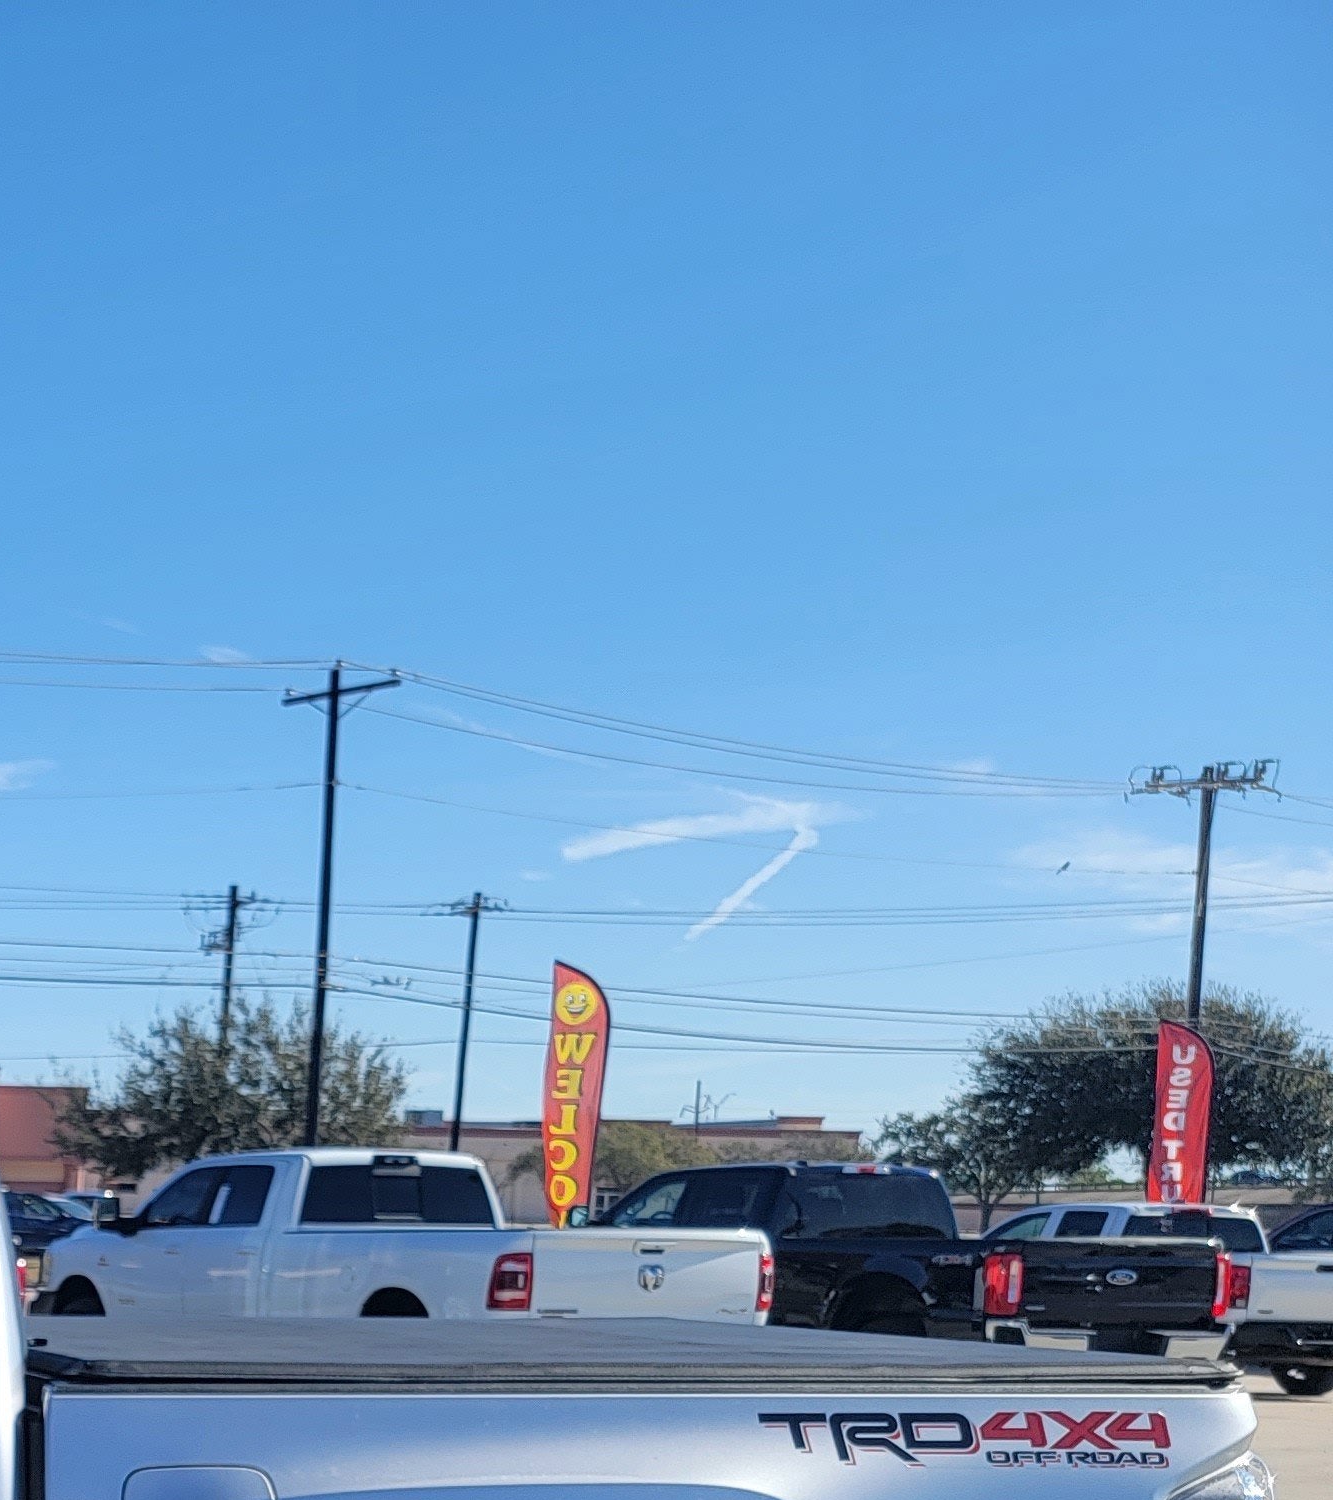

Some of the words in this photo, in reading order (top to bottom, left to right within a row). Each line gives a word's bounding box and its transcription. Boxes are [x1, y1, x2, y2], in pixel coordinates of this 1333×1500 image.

[757, 1412, 981, 1468] TRD
[979, 1410, 1172, 1450] 4X4
[985, 1450, 1060, 1469] OFF
[1065, 1450, 1170, 1469] ROAD
